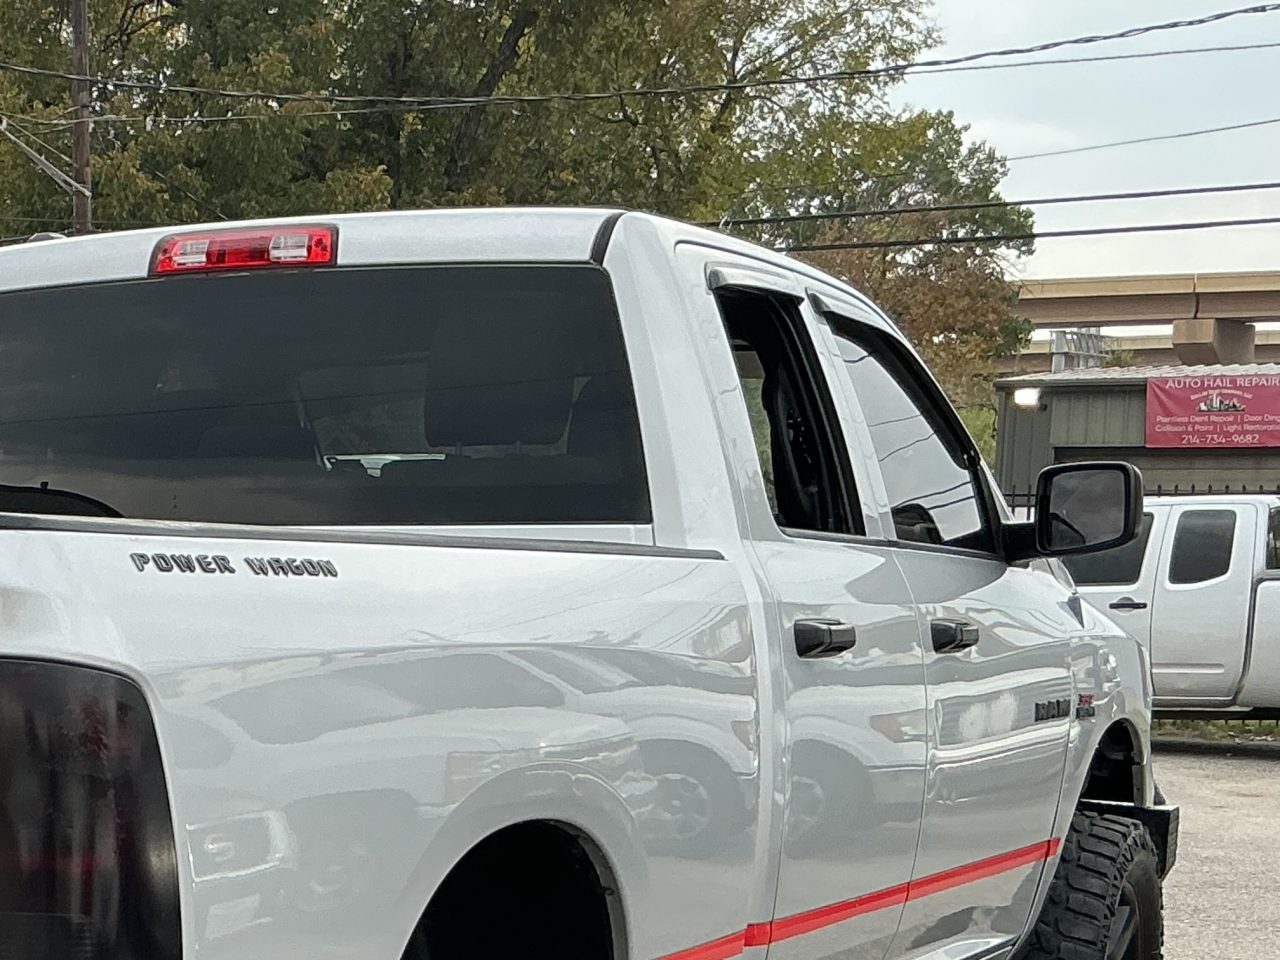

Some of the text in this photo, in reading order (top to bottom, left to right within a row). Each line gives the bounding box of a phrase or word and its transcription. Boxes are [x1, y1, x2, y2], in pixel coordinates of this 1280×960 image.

[1165, 376, 1280, 389] AUTO HAIL REPAIR
[1181, 433, 1260, 445] 214-734-9682
[129, 552, 339, 578] POWER WAGON
